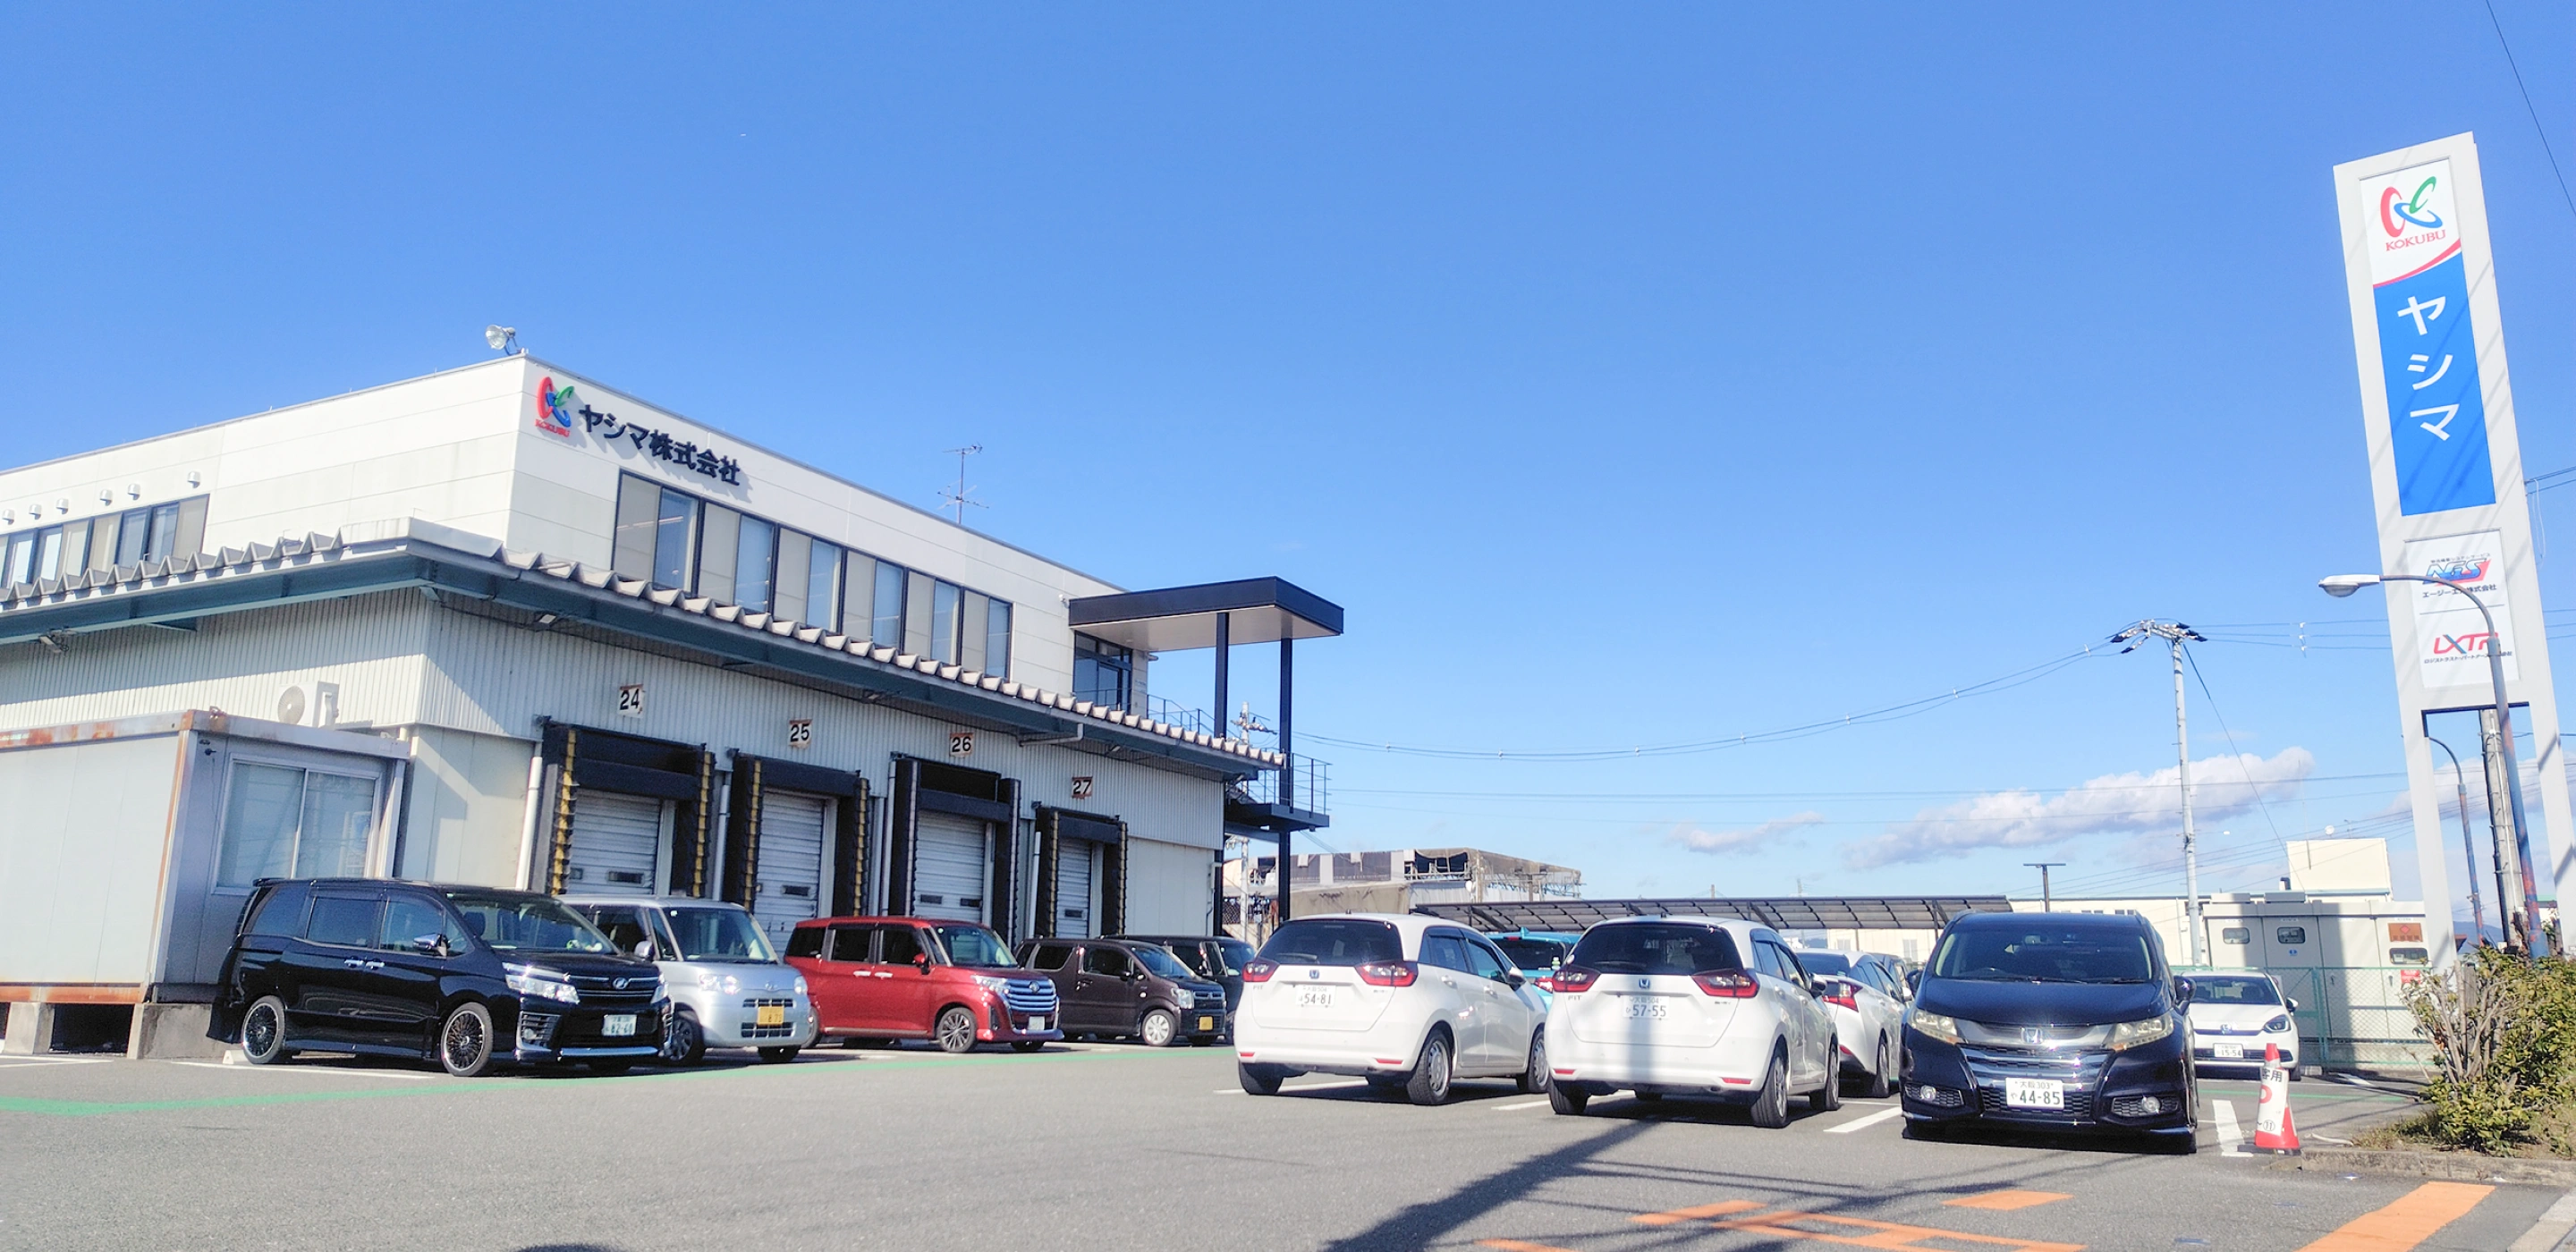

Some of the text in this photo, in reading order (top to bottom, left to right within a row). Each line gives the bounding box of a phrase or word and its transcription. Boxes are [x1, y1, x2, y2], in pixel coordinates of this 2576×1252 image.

[2385, 229, 2447, 251] KOKUBU
[2397, 295, 2460, 441] ヤシマ
[579, 403, 741, 486] ヤシマ株式会社
[619, 689, 640, 710] 24
[790, 723, 810, 742] 25
[951, 736, 972, 753] 26
[1072, 779, 1092, 794] 27
[1303, 993, 1332, 1004] 54-81
[1632, 1004, 1666, 1017] 57-55
[2020, 1089, 2061, 1104] 44-85
